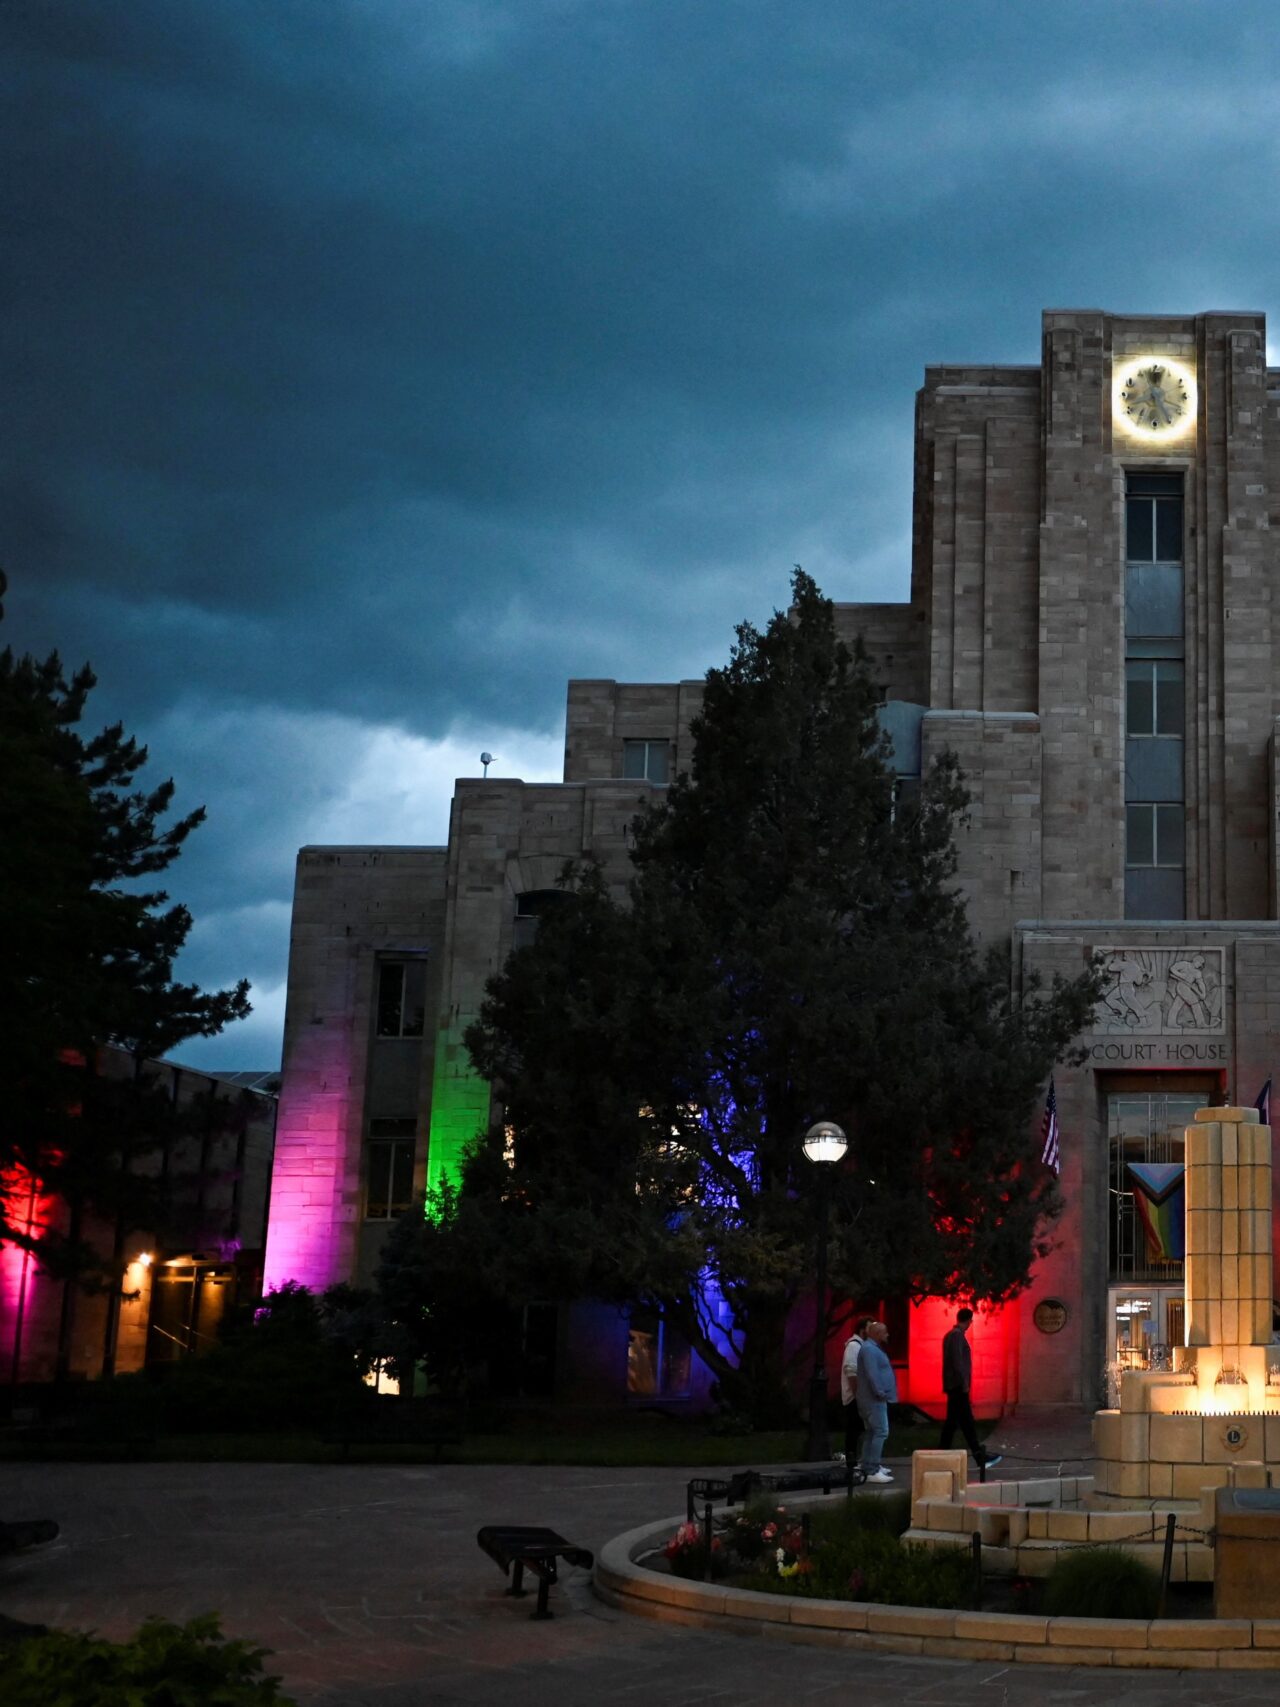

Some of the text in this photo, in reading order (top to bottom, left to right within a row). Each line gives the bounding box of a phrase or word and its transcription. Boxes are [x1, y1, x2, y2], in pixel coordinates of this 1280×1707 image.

[1092, 1044, 1227, 1060] COURT HOUSE
[1231, 1431, 1239, 1442] L
